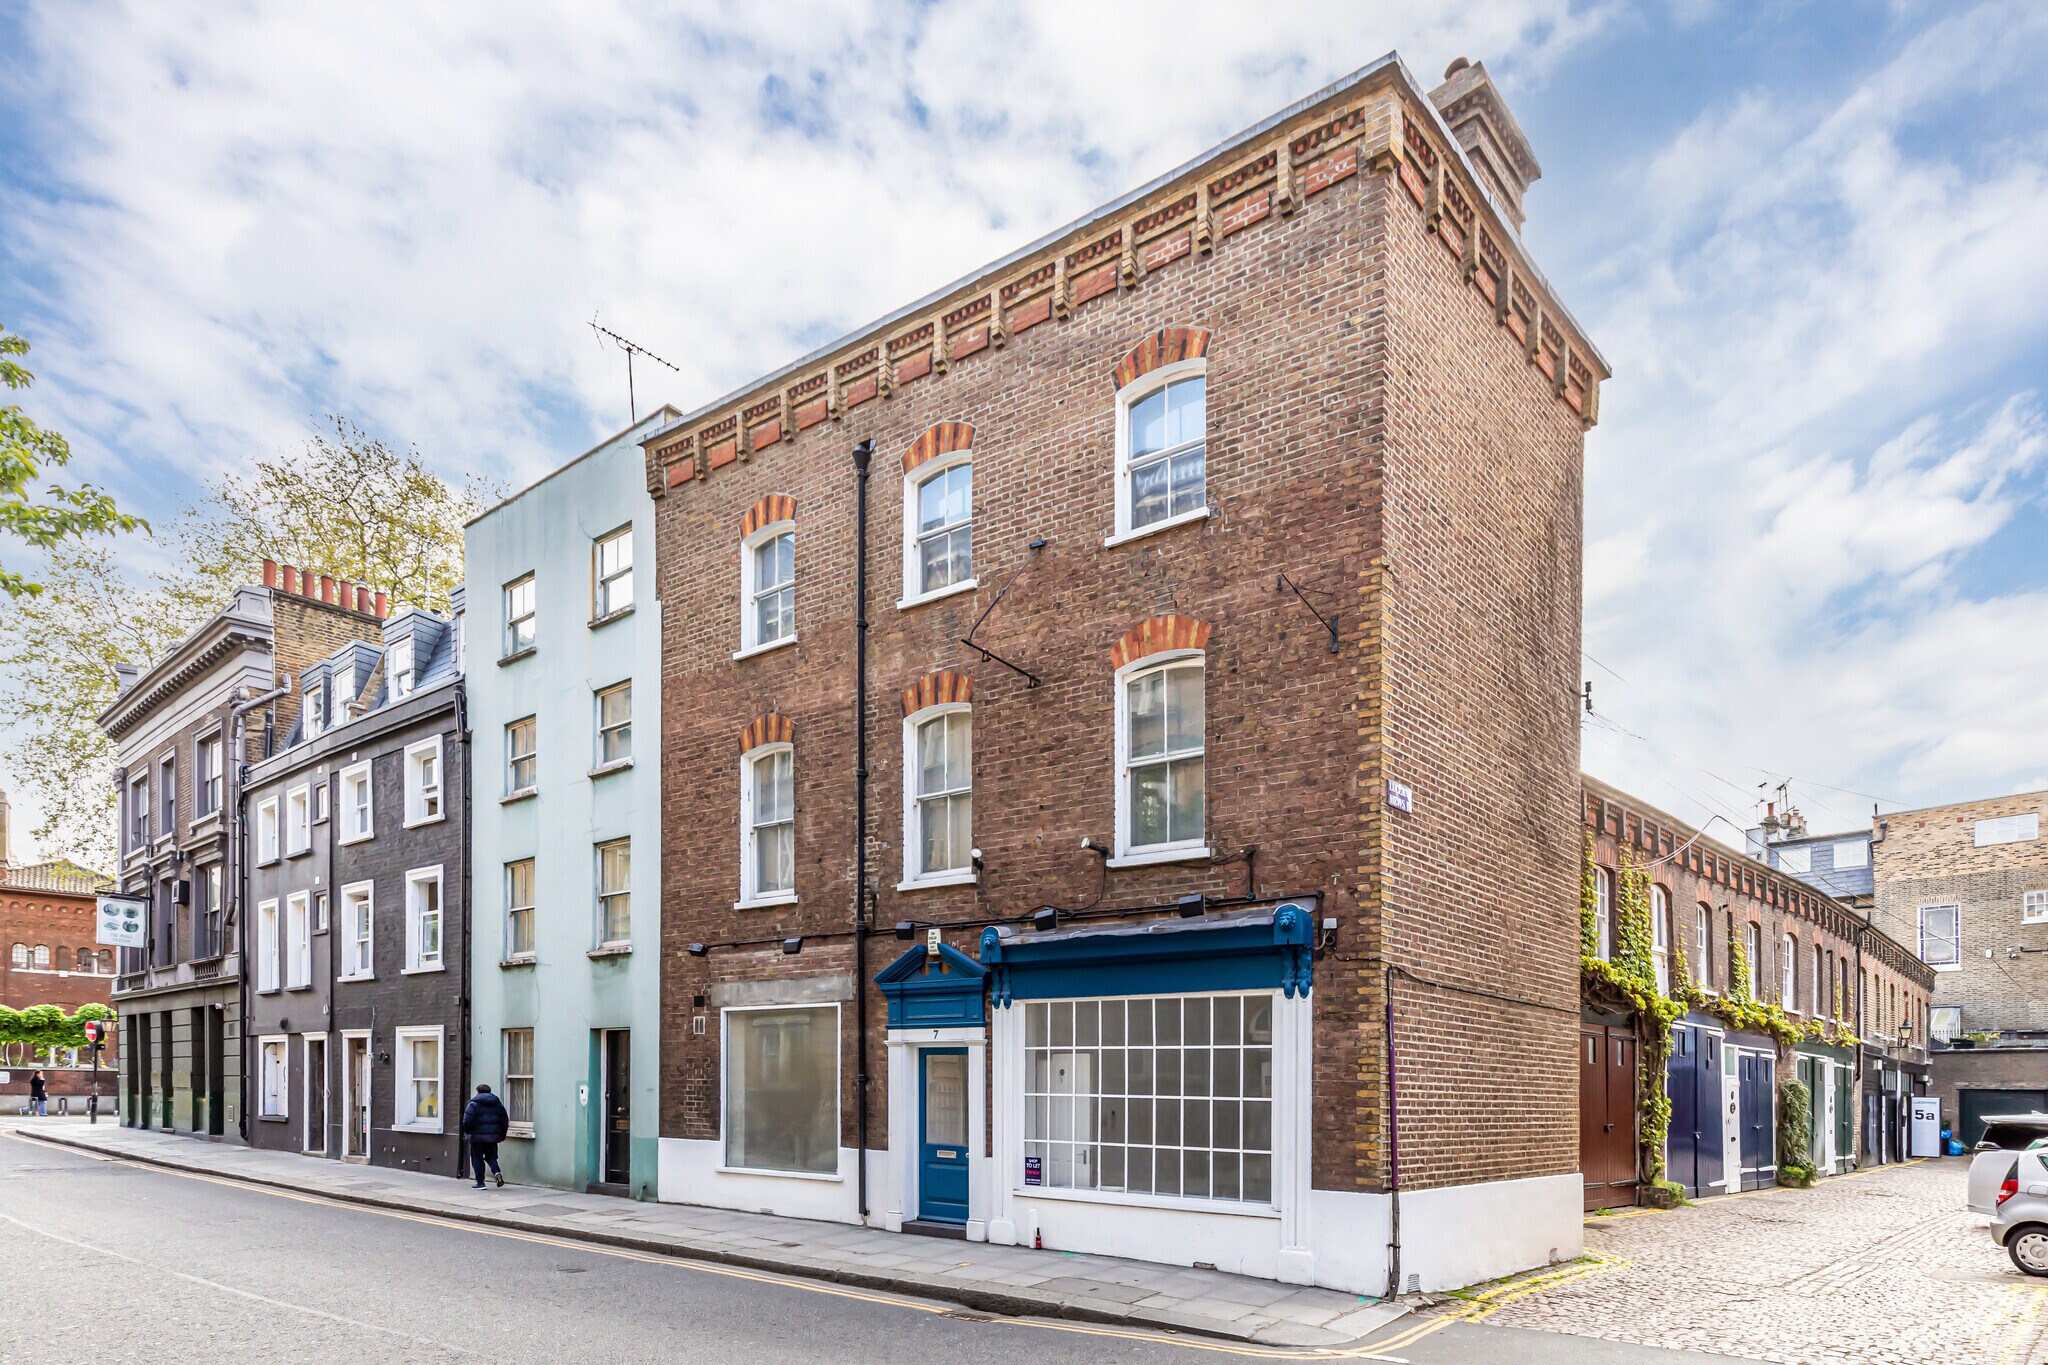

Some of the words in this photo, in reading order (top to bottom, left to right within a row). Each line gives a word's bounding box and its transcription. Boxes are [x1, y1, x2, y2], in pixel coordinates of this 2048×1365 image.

[1389, 793, 1406, 810] MEWS
[933, 1030, 939, 1039] 7
[1915, 1109, 1935, 1120] 5a
